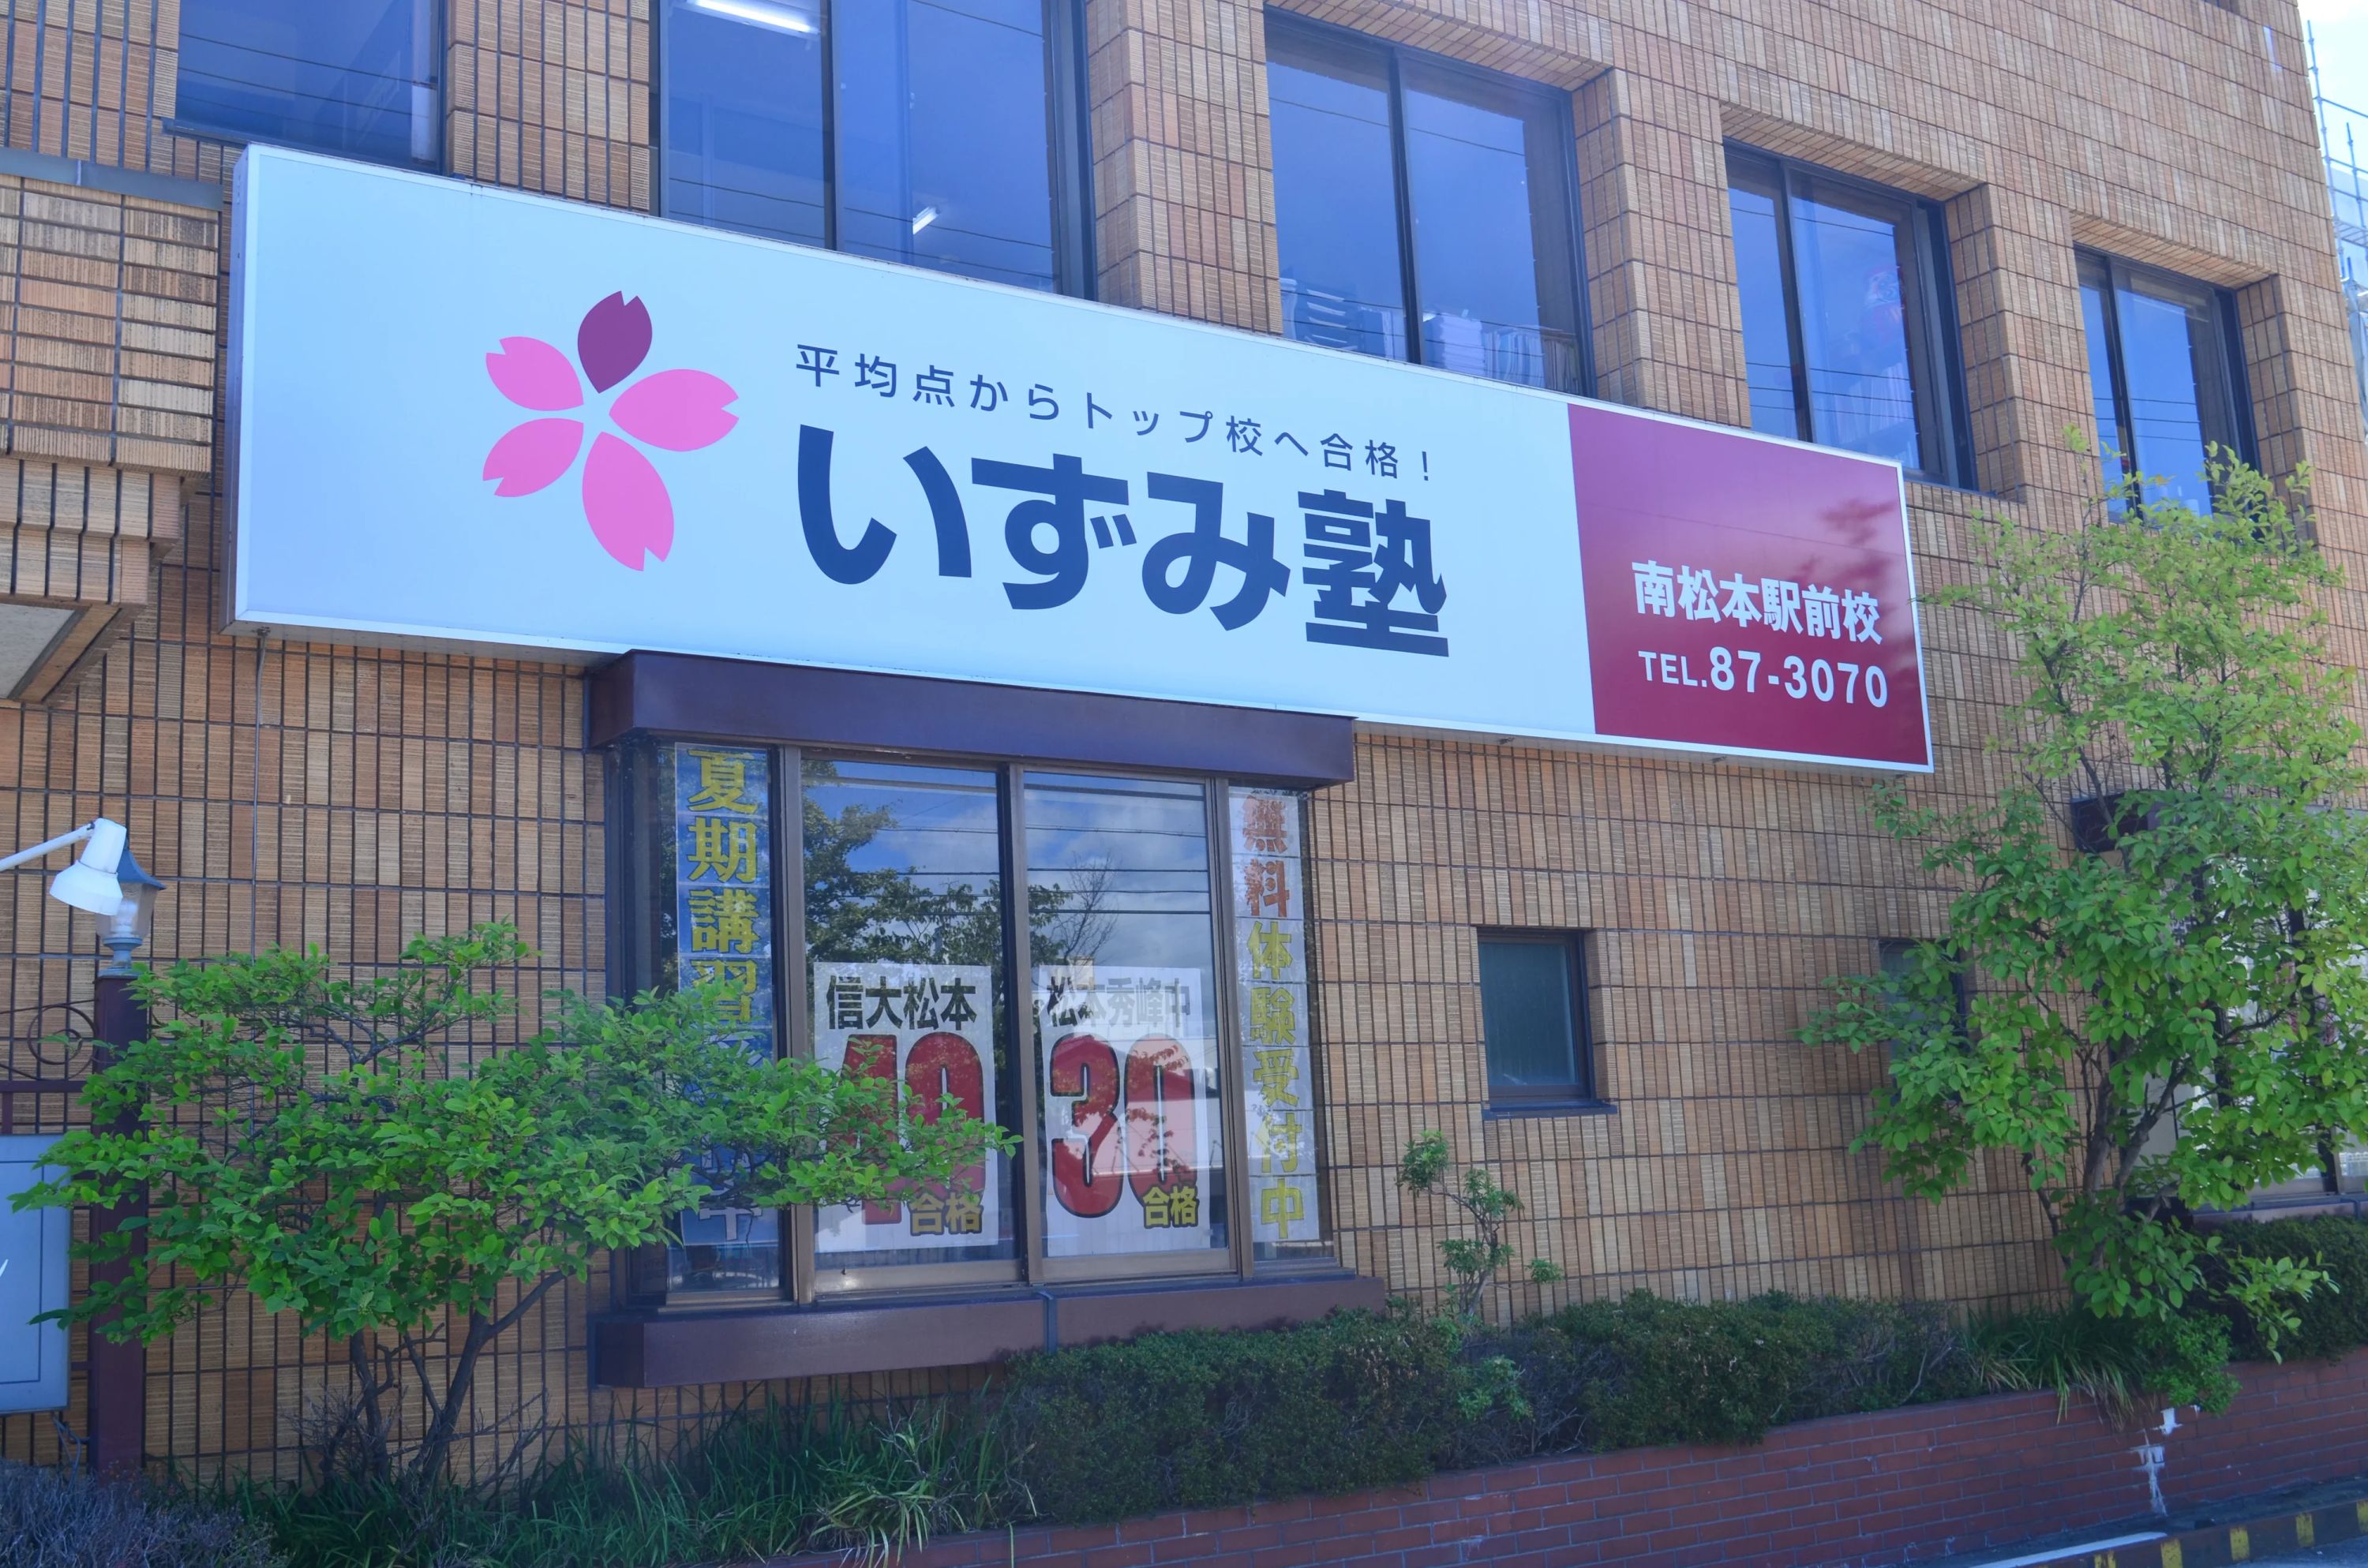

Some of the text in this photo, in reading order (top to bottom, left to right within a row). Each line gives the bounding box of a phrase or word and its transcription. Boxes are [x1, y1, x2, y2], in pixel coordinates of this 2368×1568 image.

[798, 424, 1450, 658] いずみ塾
[1632, 559, 1883, 645] 南松本駅前校
[1638, 646, 1889, 709] TEL.87-3070
[826, 975, 978, 1031] 信大松本
[1046, 976, 1192, 1028] 松本秀峰中
[1050, 1032, 1198, 1218] 30
[909, 1192, 984, 1237] 合格
[1142, 1185, 1200, 1229] 合格
